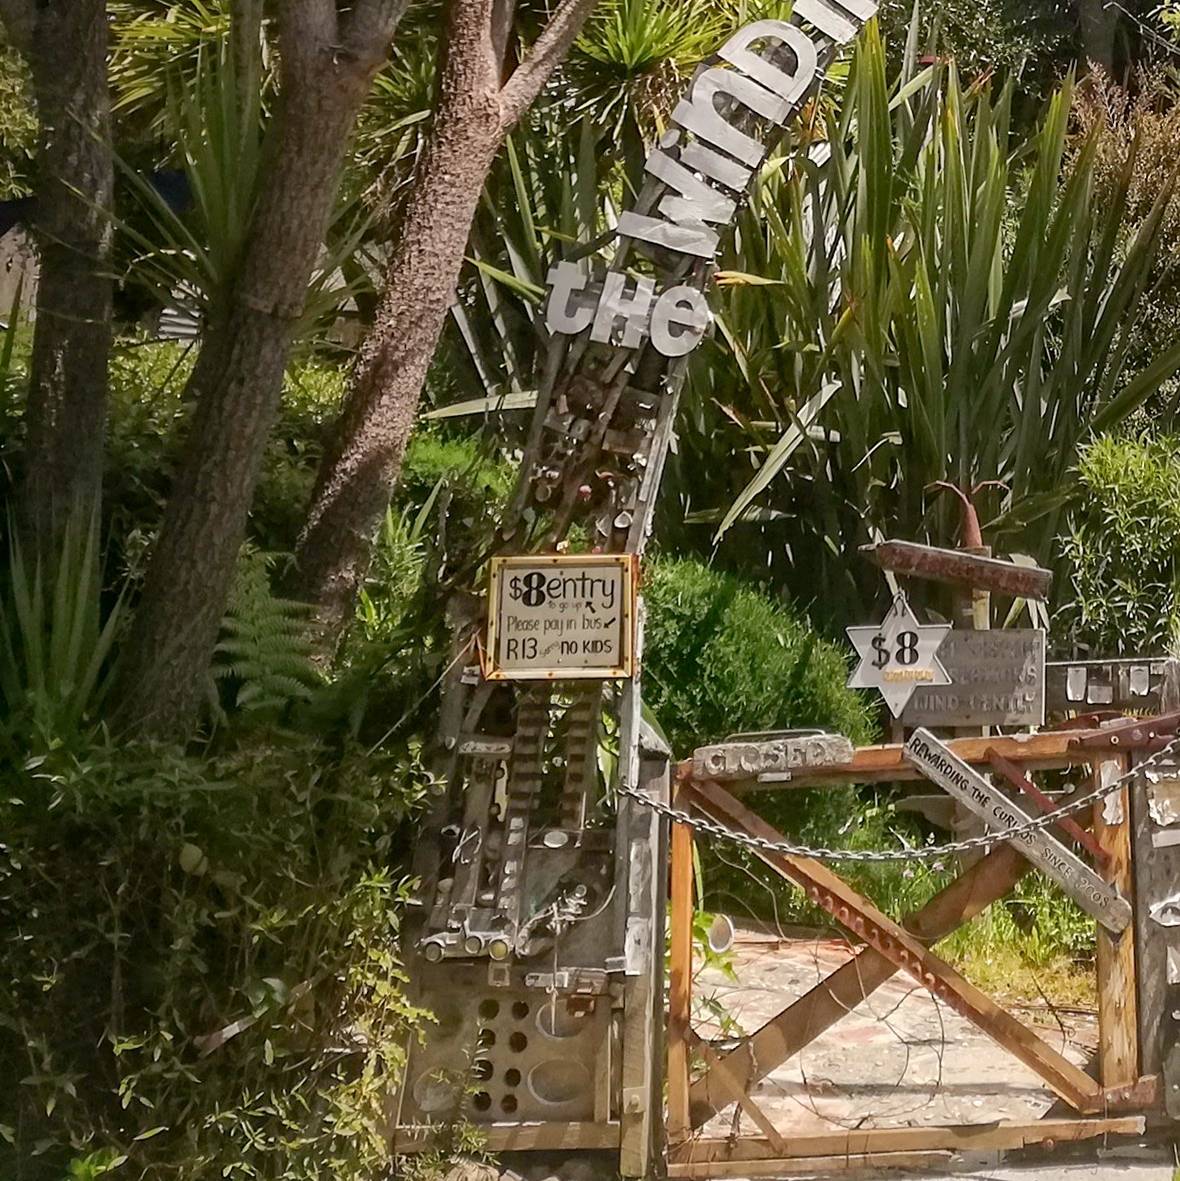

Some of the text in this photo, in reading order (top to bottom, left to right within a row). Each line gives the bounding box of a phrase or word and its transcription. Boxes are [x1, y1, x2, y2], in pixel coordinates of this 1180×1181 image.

[507, 614, 602, 636] Please pay in bus
[583, 639, 613, 654] KIDS
[871, 631, 919, 670] $8
[910, 737, 970, 795] REWARDING
[971, 786, 991, 809] THE
[1041, 847, 1074, 879] SINCE
